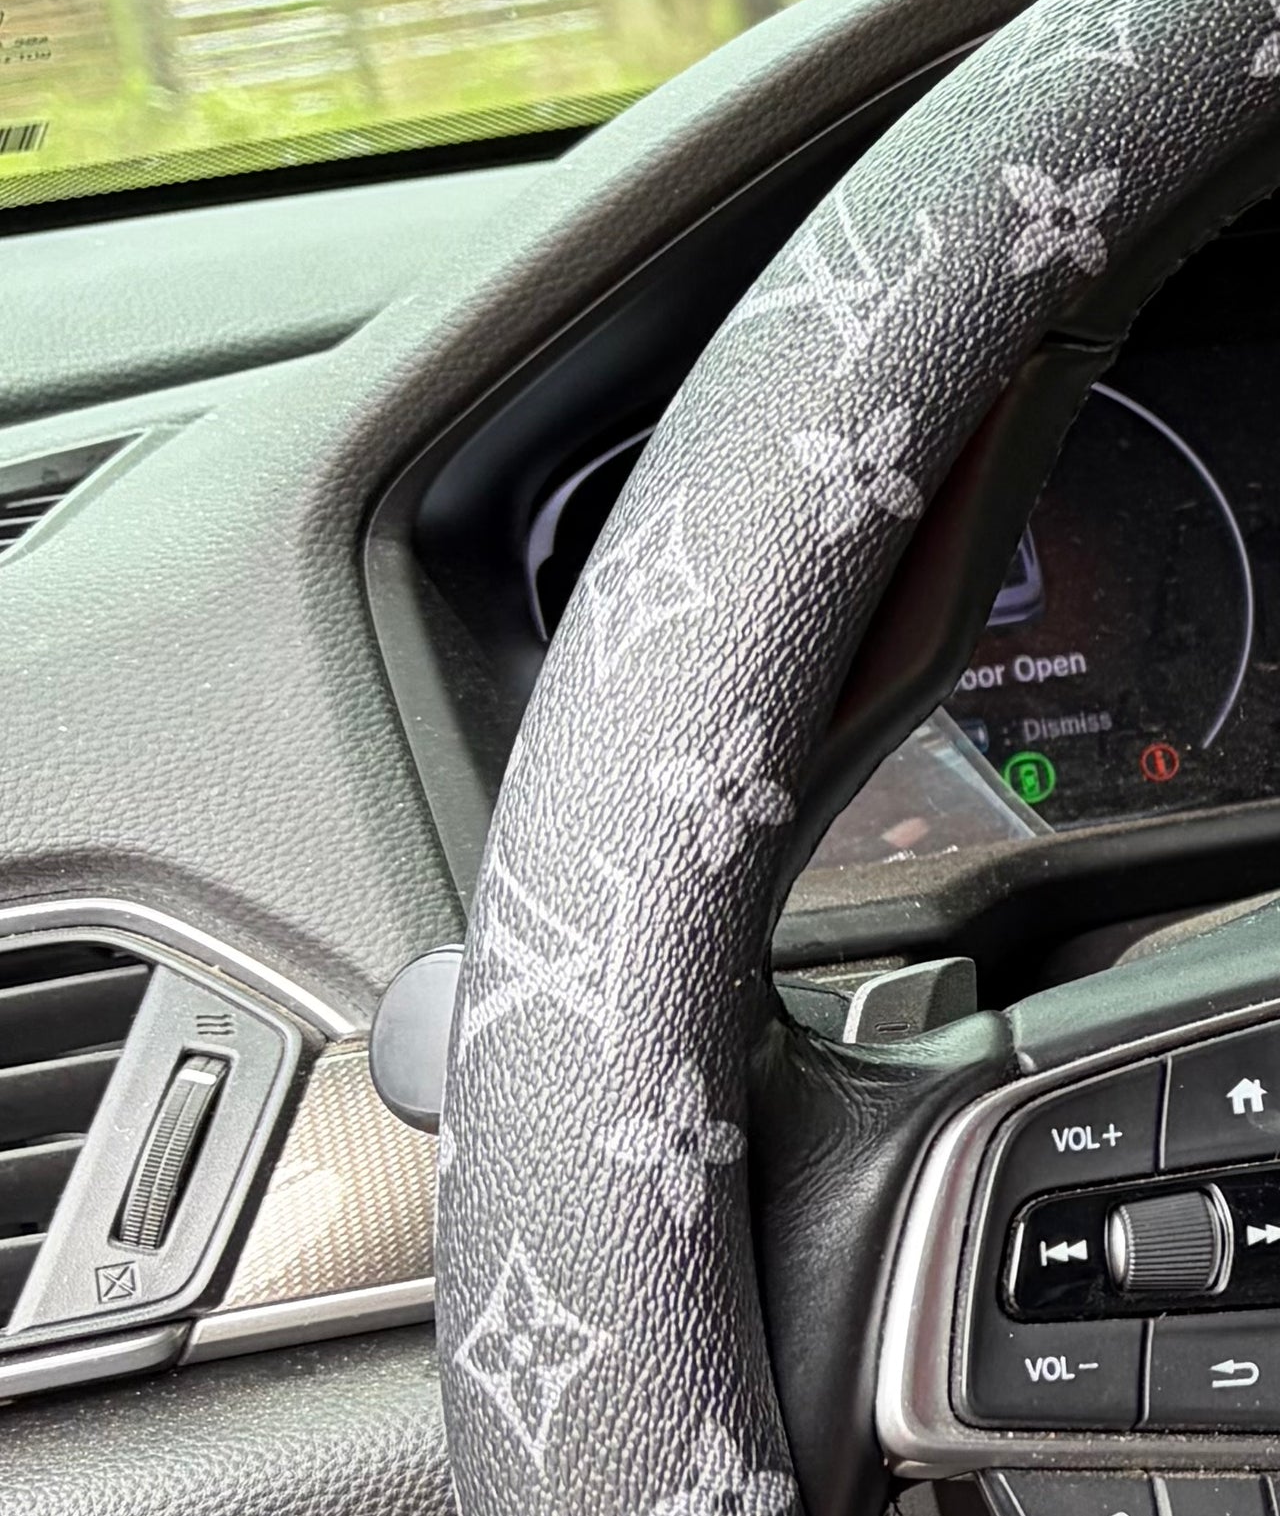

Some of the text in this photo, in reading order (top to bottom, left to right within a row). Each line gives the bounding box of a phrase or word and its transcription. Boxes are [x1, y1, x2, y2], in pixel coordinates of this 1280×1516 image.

[959, 651, 1088, 691] oor Open
[1022, 711, 1113, 742] Dismiss
